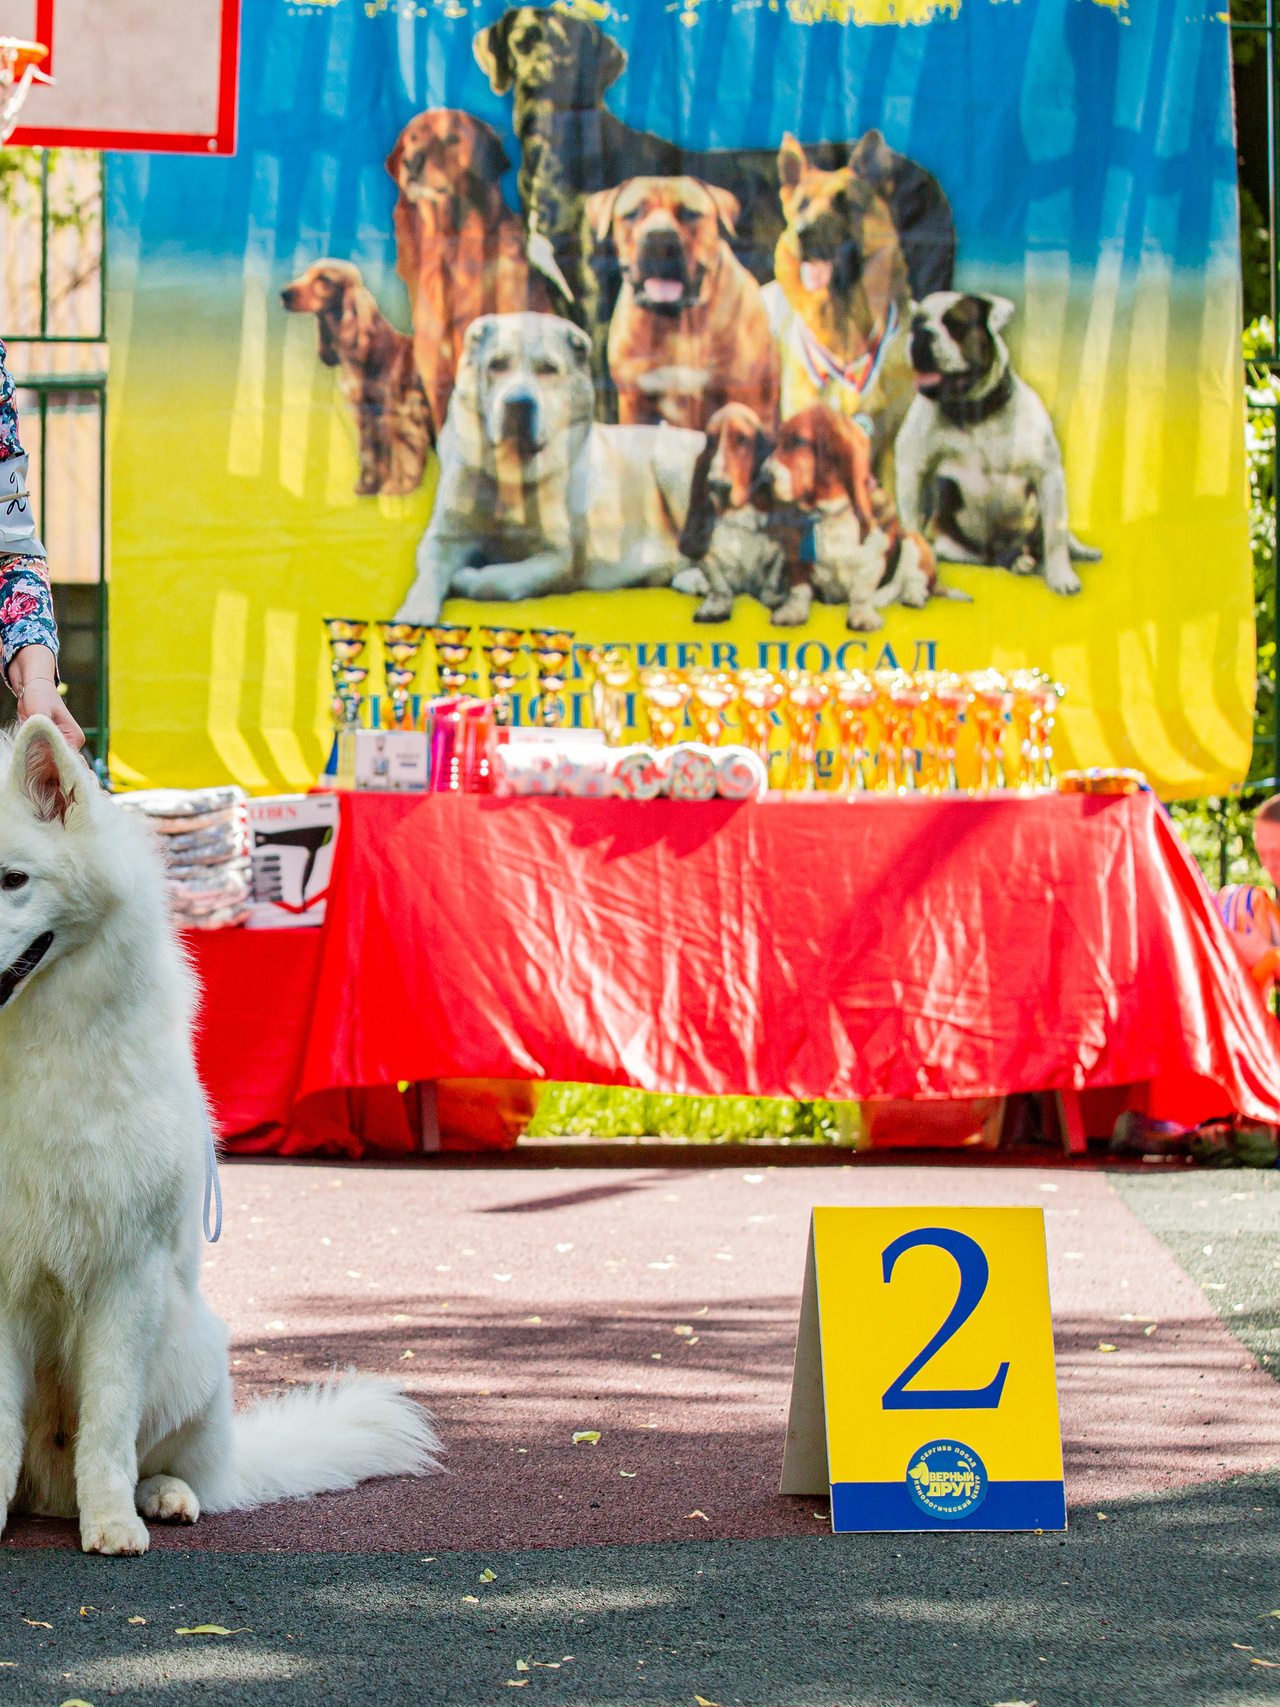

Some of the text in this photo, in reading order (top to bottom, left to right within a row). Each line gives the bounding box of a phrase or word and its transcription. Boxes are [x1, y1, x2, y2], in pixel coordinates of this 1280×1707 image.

[881, 1227, 1010, 1410] 2
[920, 1445, 977, 1468] СЕРГИЕВ ПОСАД
[926, 1482, 975, 1497] ДРУГ
[970, 1475, 981, 1499] ЦЕНТР
